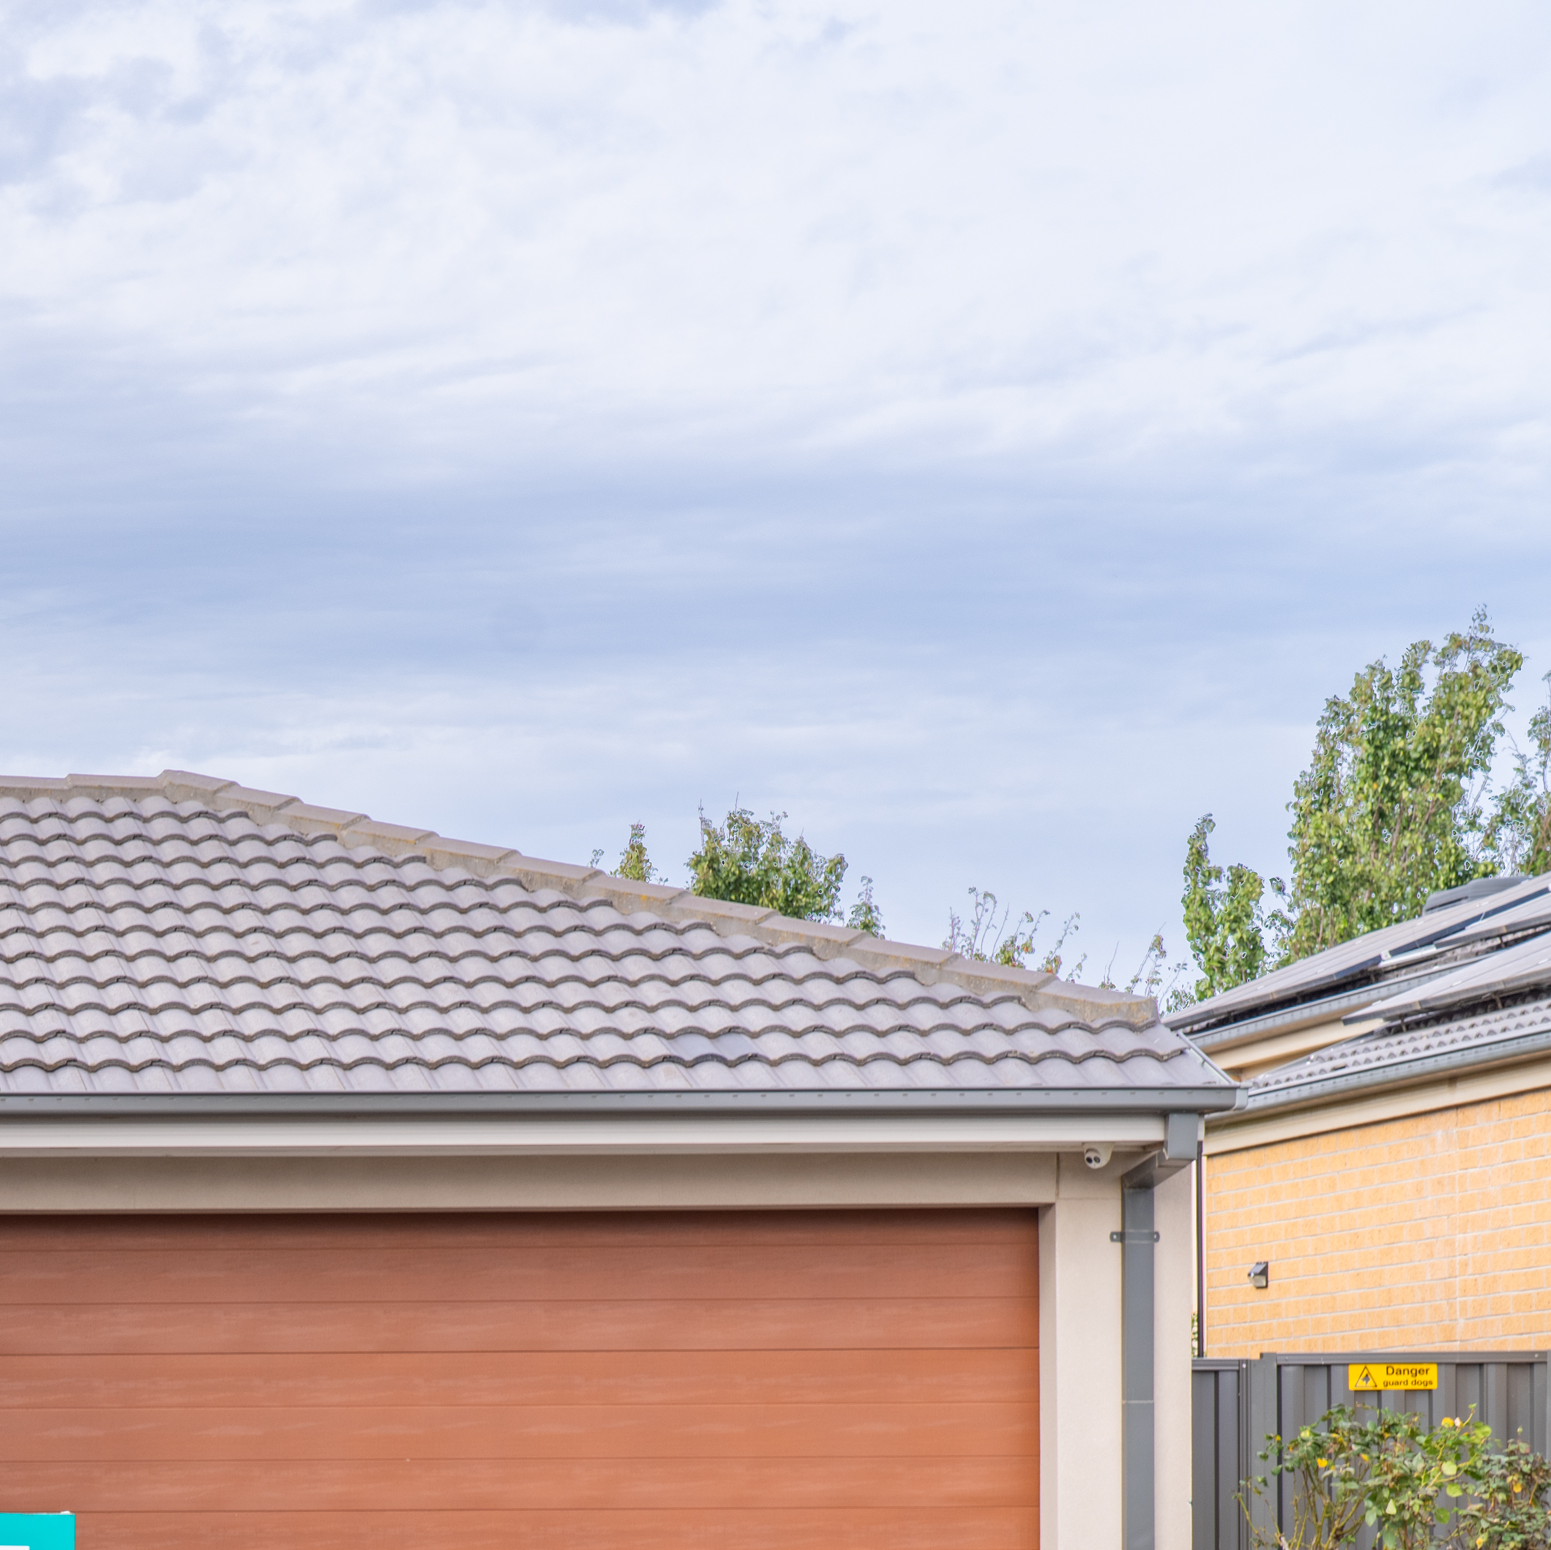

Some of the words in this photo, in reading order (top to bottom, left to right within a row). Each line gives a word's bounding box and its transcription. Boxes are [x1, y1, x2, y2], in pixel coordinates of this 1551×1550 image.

[1385, 1364, 1430, 1378] Danger
[1382, 1379, 1409, 1388] guard
[1410, 1378, 1434, 1388] dogs
